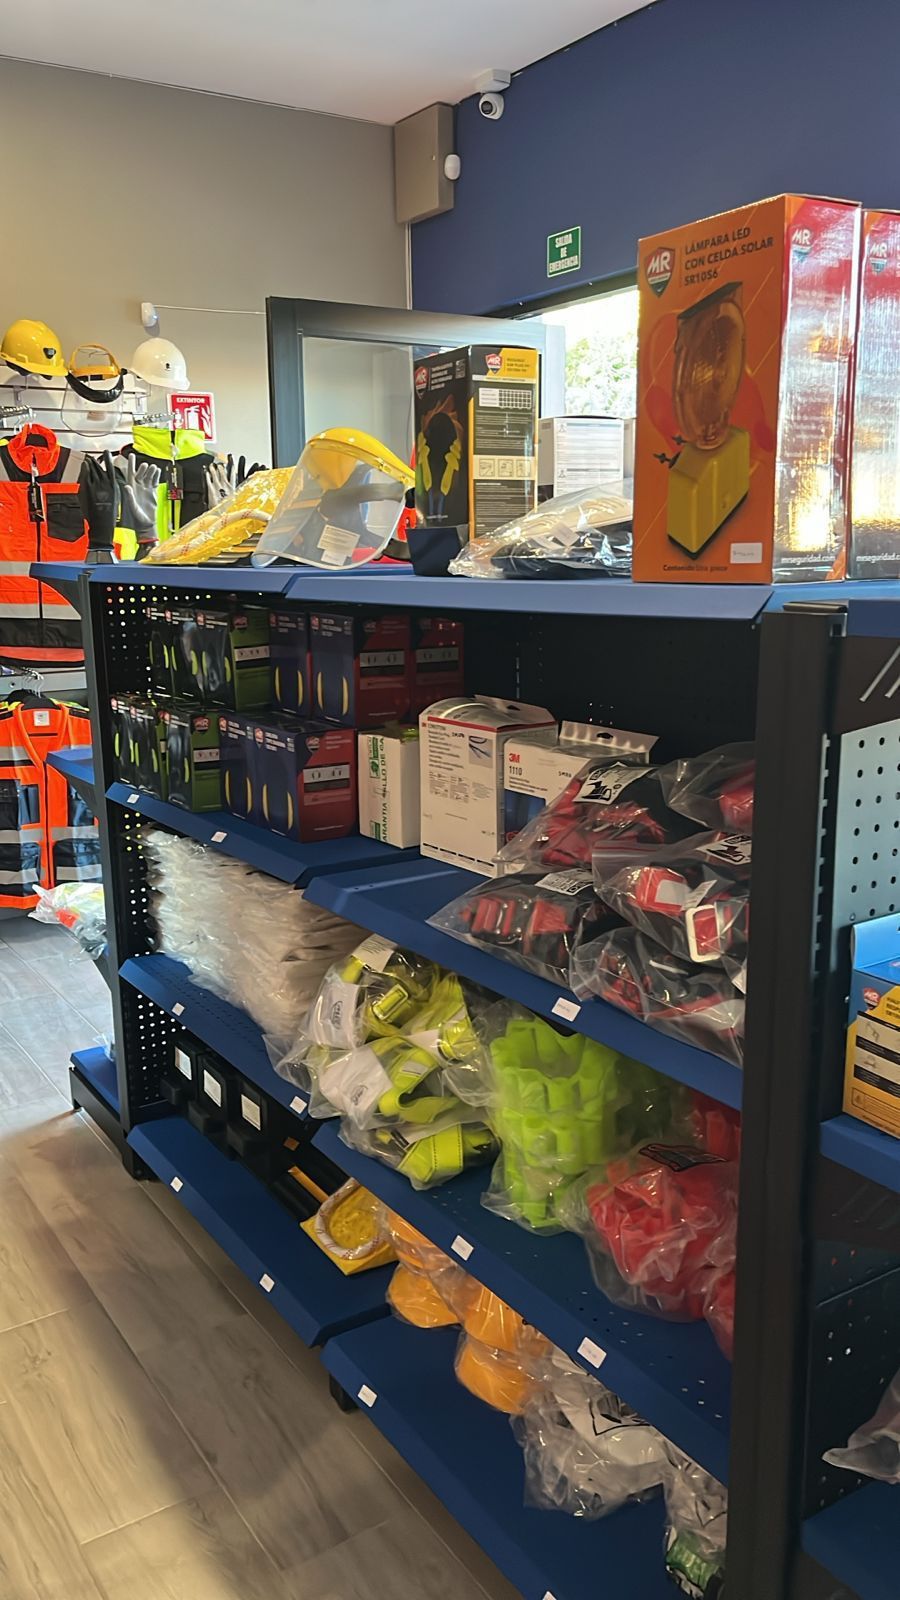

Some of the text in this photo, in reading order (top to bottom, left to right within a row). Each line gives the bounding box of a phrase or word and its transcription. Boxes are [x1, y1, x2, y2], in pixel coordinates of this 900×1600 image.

[555, 233, 573, 249] SALIDA
[732, 226, 751, 241] LED
[791, 228, 811, 245] MR
[560, 246, 568, 259] DE
[684, 236, 774, 270] CON CELDA SOLAR
[870, 242, 887, 258] MR
[549, 254, 578, 273] EMERGENCIA
[647, 251, 671, 276] MR
[780, 552, 836, 565] mrseguridad.com
[380, 753, 386, 766] DE
[508, 753, 521, 763] 3M
[508, 765, 523, 776] 1110
